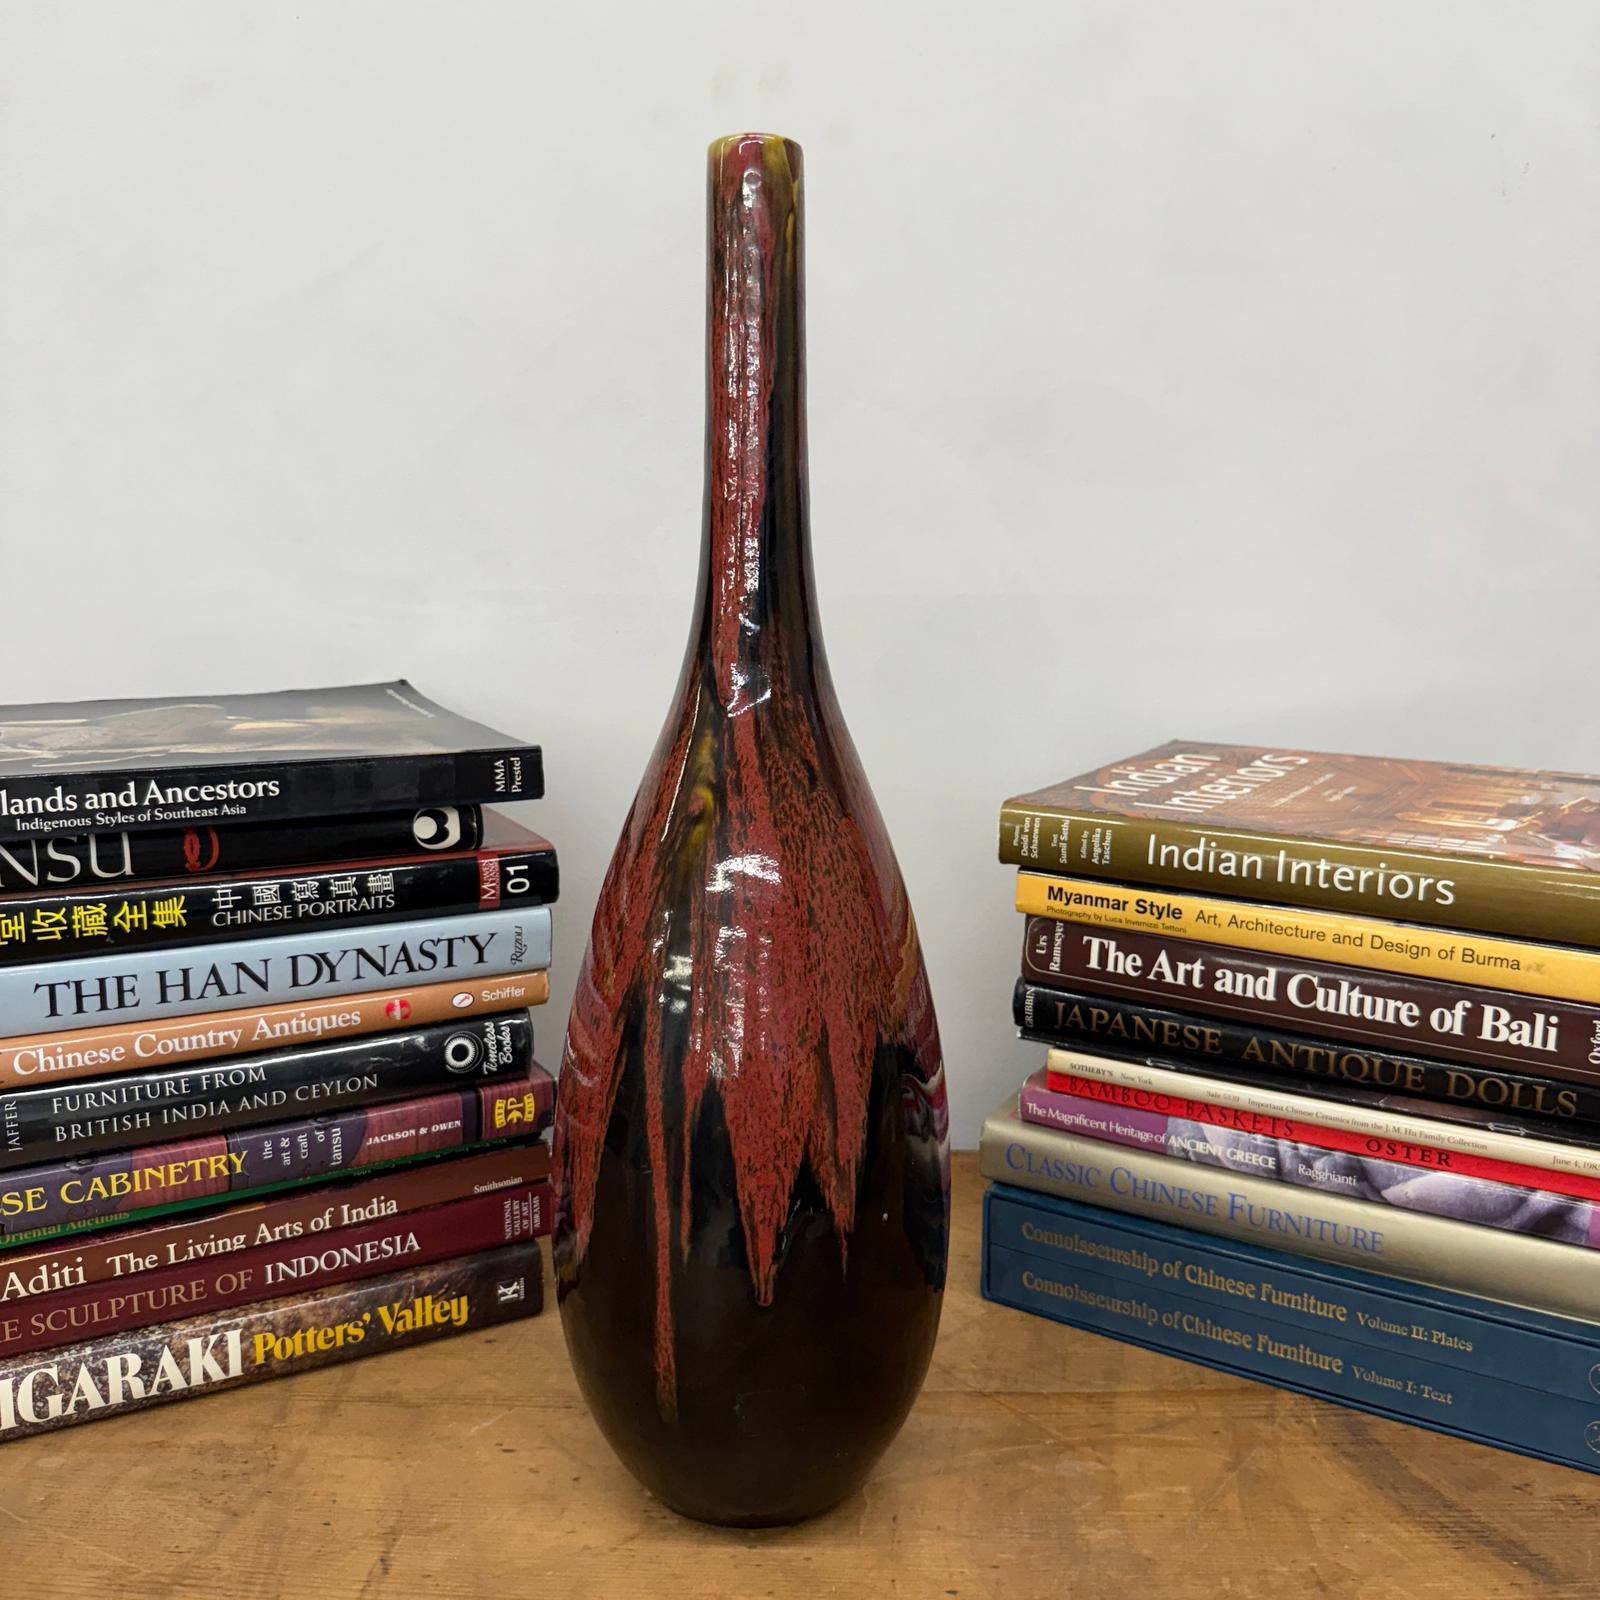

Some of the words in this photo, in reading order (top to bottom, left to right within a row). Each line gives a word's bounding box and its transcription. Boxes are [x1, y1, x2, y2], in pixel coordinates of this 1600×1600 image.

[493, 759, 505, 792] MMA
[511, 757, 522, 792] Prestel
[1074, 752, 1221, 796] Indian
[1133, 753, 1309, 814] Interiors
[84, 781, 138, 811] and
[142, 779, 280, 806] Ancestors
[16, 814, 92, 832] Indigenous
[96, 811, 135, 827] Styles
[138, 809, 151, 822] of
[154, 806, 219, 821] Southeast
[221, 804, 247, 816] Asia
[1023, 817, 1031, 833] von
[1030, 817, 1041, 859] Schaewen
[1060, 819, 1070, 841] Sethi
[1020, 834, 1029, 856] Deidi
[1059, 842, 1068, 864] Sunil
[1091, 828, 1102, 865] Angelika
[1102, 829, 1112, 865] Taschen
[505, 865, 530, 894] 01
[1147, 834, 1263, 880] Indian
[1277, 849, 1456, 905] Interiors
[213, 903, 293, 927] CHINESE
[299, 893, 395, 917] PORTRAITS
[1046, 905, 1092, 921] Photography
[1093, 912, 1103, 922] by
[1104, 914, 1122, 925] Luca
[1047, 885, 1129, 911] Myanmar
[1135, 899, 1183, 921] Style
[1195, 909, 1222, 928] Art,
[1227, 914, 1327, 941] Architecture
[1332, 933, 1363, 947] and
[1370, 935, 1431, 960] Design
[1437, 946, 1455, 960] of
[1462, 948, 1521, 971] Burma
[1035, 934, 1047, 955] Urs
[1049, 920, 1064, 972] Ramseyer
[33, 974, 141, 1018] THE
[156, 958, 272, 1005] HAN
[287, 932, 498, 989] DYNASTY
[481, 985, 526, 1002] Schiffer
[1083, 935, 1142, 977] The
[1147, 949, 1205, 989] Art
[1213, 967, 1276, 1001] and
[1286, 972, 1421, 1028] Culture
[1429, 1000, 1473, 1036] of
[1477, 1004, 1560, 1052] Bali
[1025, 986, 1035, 1028] GRIBBIN
[13, 1043, 126, 1075] Chinese
[134, 1028, 243, 1058] Country
[252, 1010, 361, 1041] Antiques
[483, 1021, 495, 1075] Timeless
[498, 1025, 513, 1065] Books
[1054, 1000, 1223, 1054] JAPANESE
[1241, 1036, 1425, 1092] ANTIQUE
[1446, 1069, 1578, 1117] DOLLS
[52, 1077, 191, 1114] FURNITURE
[201, 1065, 267, 1090] FROM
[55, 1111, 151, 1143] BRITISH
[162, 1101, 232, 1125] INDIA
[238, 1089, 287, 1112] AND
[295, 1074, 379, 1101] CEYLON
[4, 1100, 23, 1152] JAFFER
[366, 1128, 416, 1146] JACKSON
[419, 1126, 428, 1135] &
[431, 1119, 461, 1133] OWEN
[1068, 1075, 1171, 1112] BAMBOO
[1185, 1101, 1294, 1137] BASKETS
[1365, 1138, 1452, 1168] OSTER
[1069, 1062, 1114, 1078] SOTHEBY'S
[1120, 1073, 1135, 1082] New
[1137, 1075, 1153, 1086] York
[1285, 1105, 1314, 1118] Chinese
[1315, 1111, 1350, 1125] Ceramics
[1351, 1117, 1369, 1128] from
[1371, 1121, 1383, 1130] the
[1404, 1128, 1417, 1137] Hu
[1418, 1129, 1446, 1144] Family
[1447, 1136, 1488, 1151] Collection
[1552, 1155, 1572, 1167] June
[262, 1139, 273, 1159] the
[280, 1137, 291, 1148] &
[297, 1133, 308, 1159] craft
[314, 1129, 326, 1142] of
[1026, 1102, 1046, 1116] The
[1047, 1106, 1107, 1132] Magnificent
[1108, 1121, 1155, 1143] Heritage
[1154, 1131, 1169, 1144] of
[1168, 1135, 1222, 1157] ANCIENT
[1226, 1148, 1276, 1169] GREECE
[1298, 1163, 1356, 1186] Ragghianti
[59, 1150, 249, 1205] CABINETRY
[280, 1151, 291, 1166] art
[473, 1174, 523, 1193] Smithsonian
[1005, 1142, 1100, 1188] CLASSIC
[1109, 1166, 1219, 1216] CHINESE
[1227, 1191, 1384, 1253] FURNITURE
[503, 1198, 512, 1240] NATIONAL
[512, 1199, 521, 1236] GALLERY
[521, 1201, 530, 1217] ART
[521, 1218, 530, 1230] OF
[532, 1195, 541, 1228] ABRAMS
[1, 1256, 87, 1300] Aditi
[106, 1252, 159, 1277] The
[166, 1233, 247, 1265] Living
[253, 1219, 304, 1245] Arts
[310, 1207, 335, 1231] of
[340, 1196, 399, 1225] India
[31, 1279, 207, 1336] SCULPTURE
[215, 1269, 253, 1295] OF
[264, 1231, 421, 1284] INDONESIA
[1021, 1221, 1159, 1277] Connoisseurship
[1162, 1260, 1183, 1280] of
[1184, 1264, 1256, 1298] Chinese
[1260, 1283, 1347, 1322] Furniture
[1356, 1311, 1408, 1336] Volume
[1410, 1325, 1428, 1342] II:
[1431, 1331, 1473, 1352] Plates
[253, 1311, 372, 1365] Potters'
[377, 1294, 469, 1335] Valley
[1021, 1270, 1158, 1327] Connoisseurship
[1162, 1310, 1181, 1329] of
[1182, 1314, 1253, 1349] Chinese
[1256, 1334, 1343, 1374] Furniture
[1351, 1365, 1404, 1391] Volume
[1406, 1380, 1417, 1395] I:
[1420, 1384, 1453, 1405] Text
